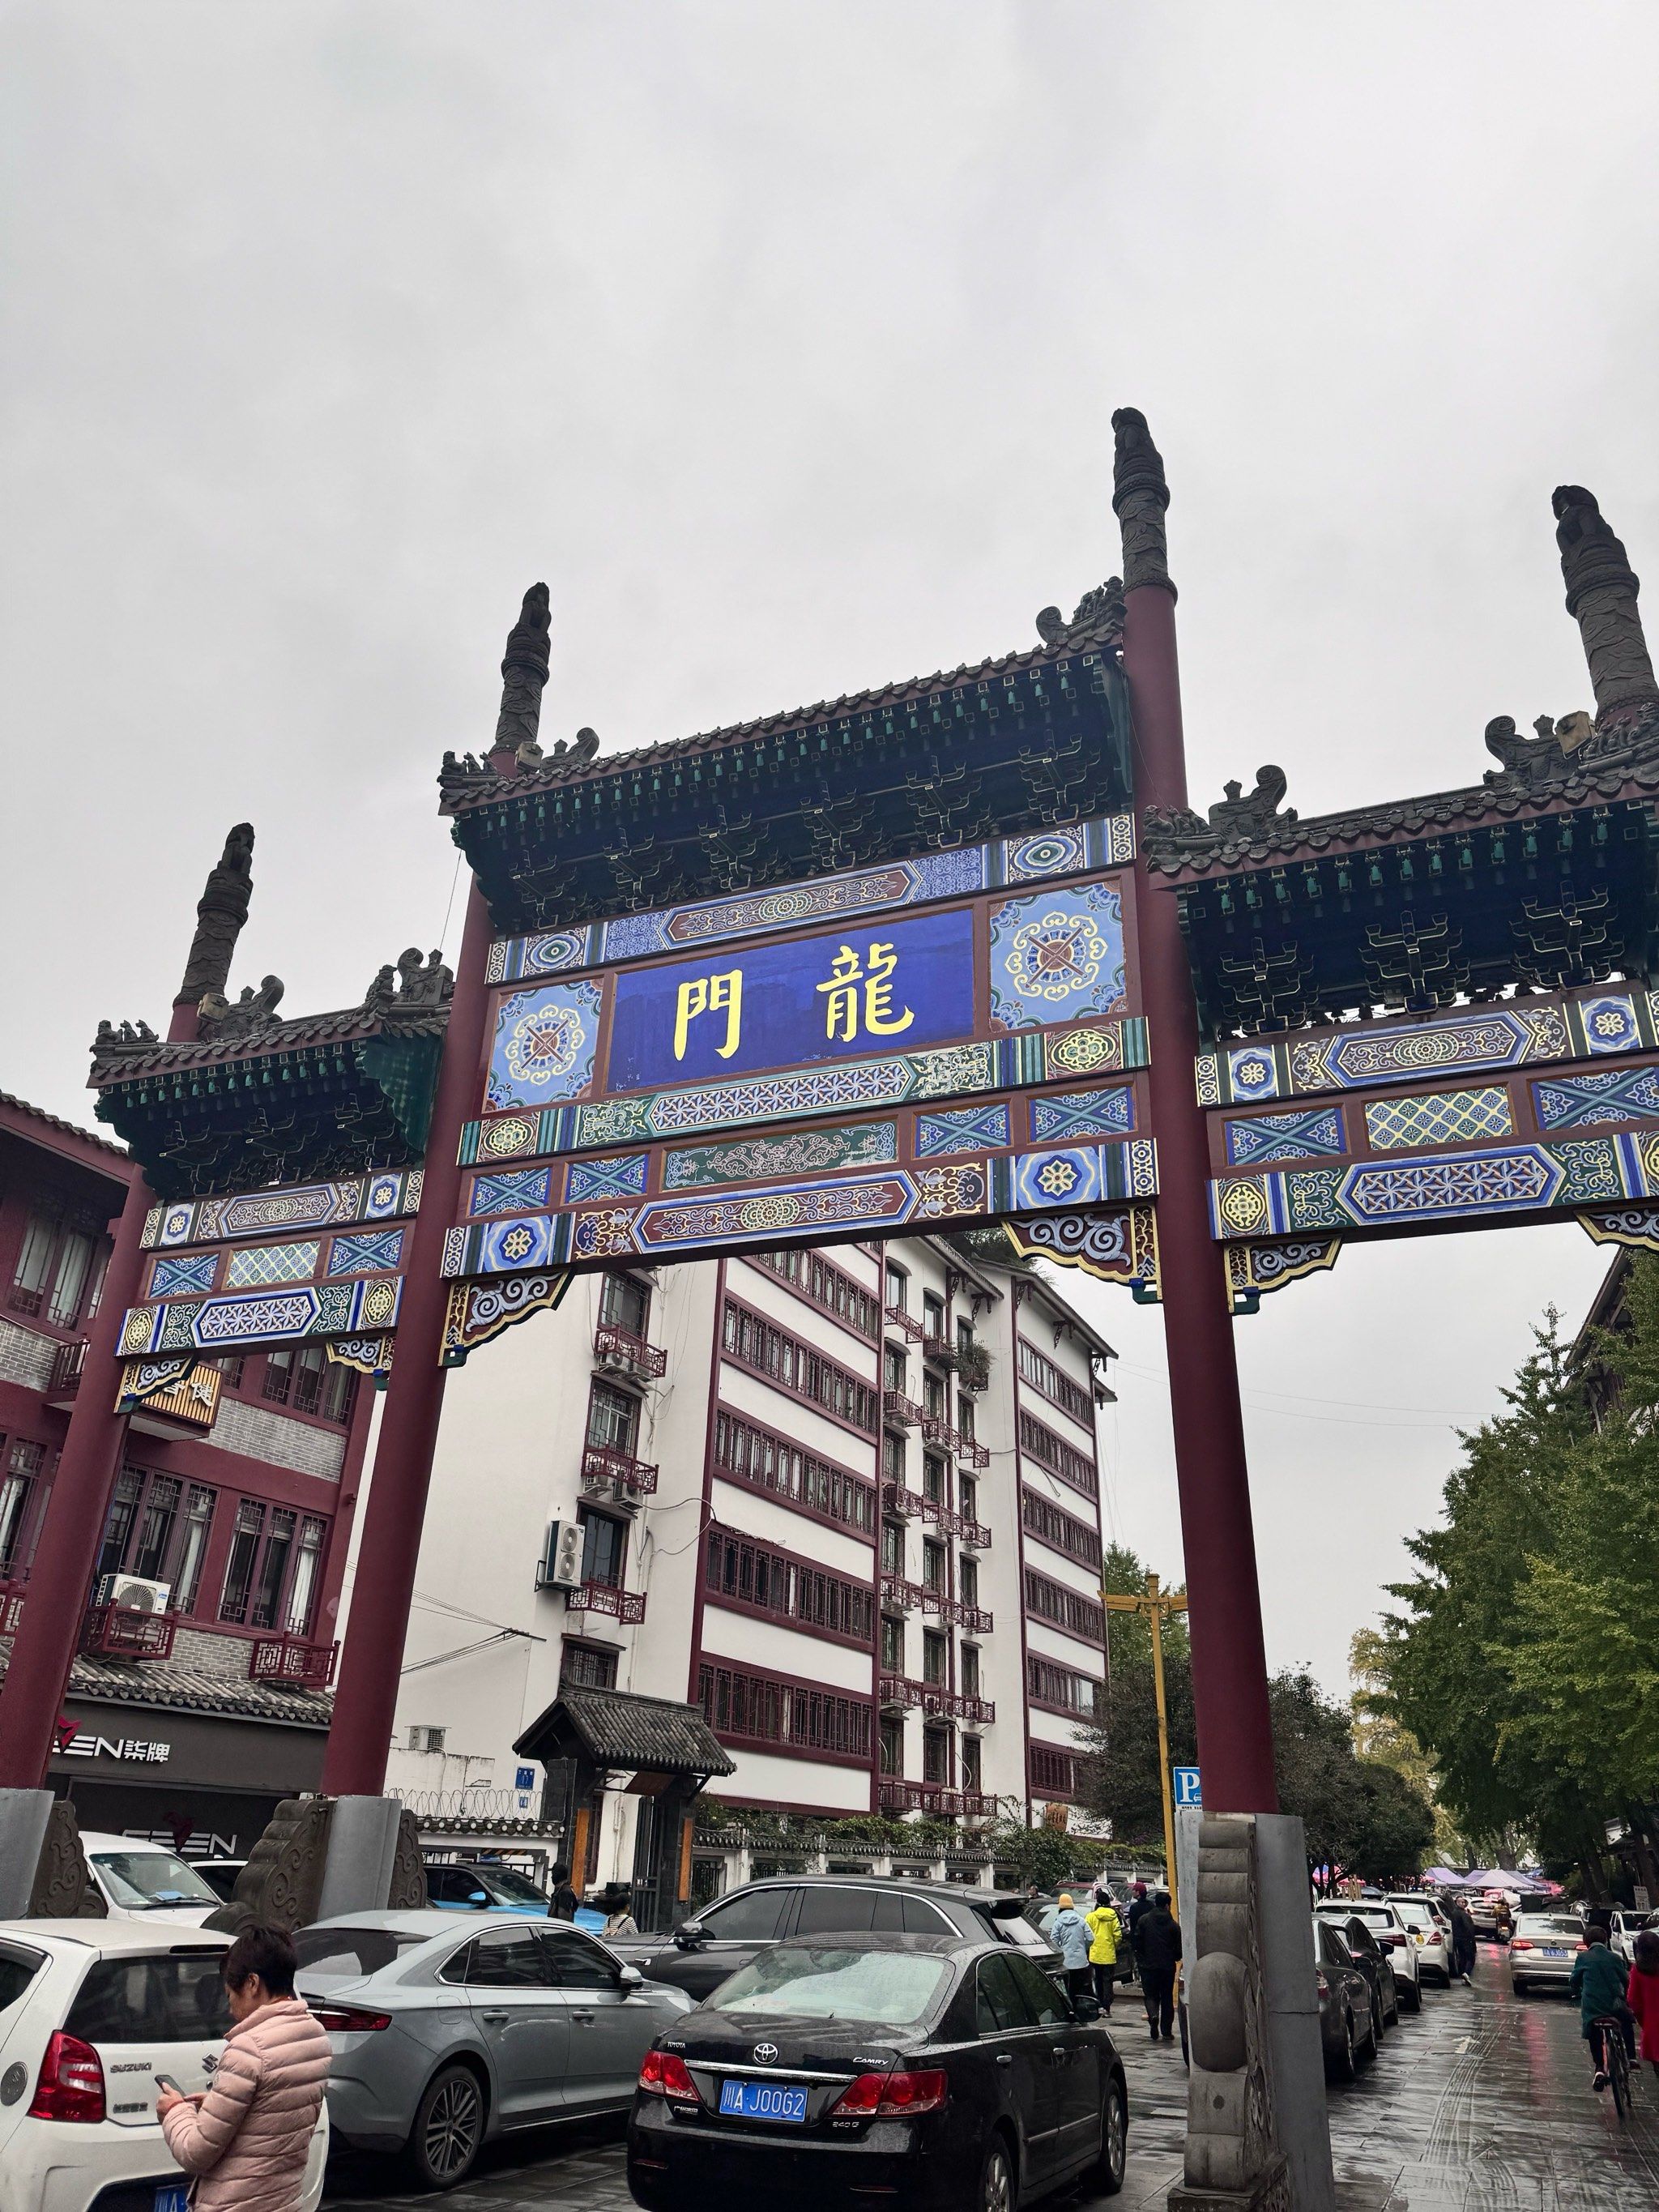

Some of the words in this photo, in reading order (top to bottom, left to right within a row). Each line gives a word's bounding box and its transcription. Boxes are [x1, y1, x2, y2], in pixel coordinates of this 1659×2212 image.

[123, 1740, 170, 1762] 柒牌
[1178, 1772, 1201, 1803] P
[110, 2062, 152, 2073] SUZUKI
[853, 2056, 889, 2066] CAMRY
